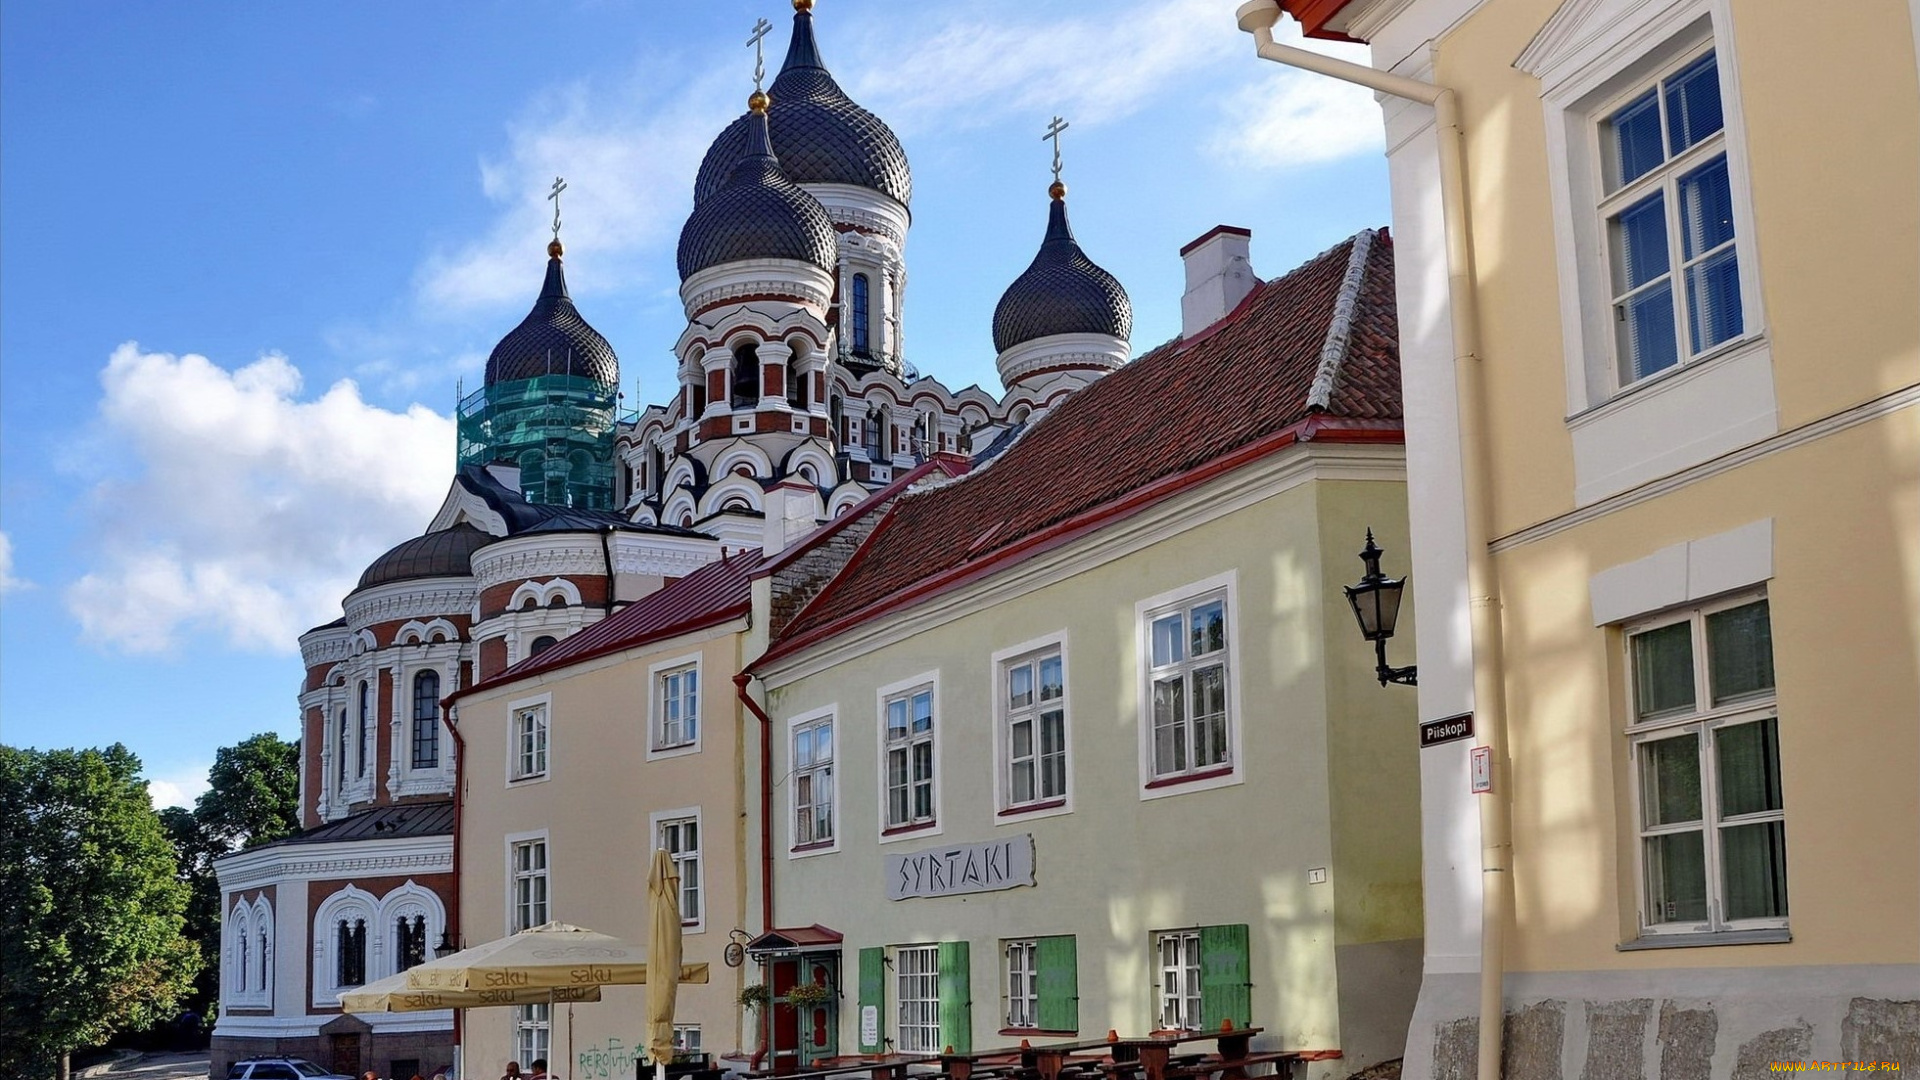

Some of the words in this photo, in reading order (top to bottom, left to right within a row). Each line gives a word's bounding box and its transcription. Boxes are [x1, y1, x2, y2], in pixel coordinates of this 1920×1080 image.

[1427, 720, 1467, 739] Piiskopi
[900, 843, 1012, 896] SYRTAKI
[485, 967, 528, 987] saku
[570, 965, 612, 983] saku
[404, 991, 443, 1008] saku
[479, 989, 515, 1004] saku
[552, 986, 585, 1000] saku
